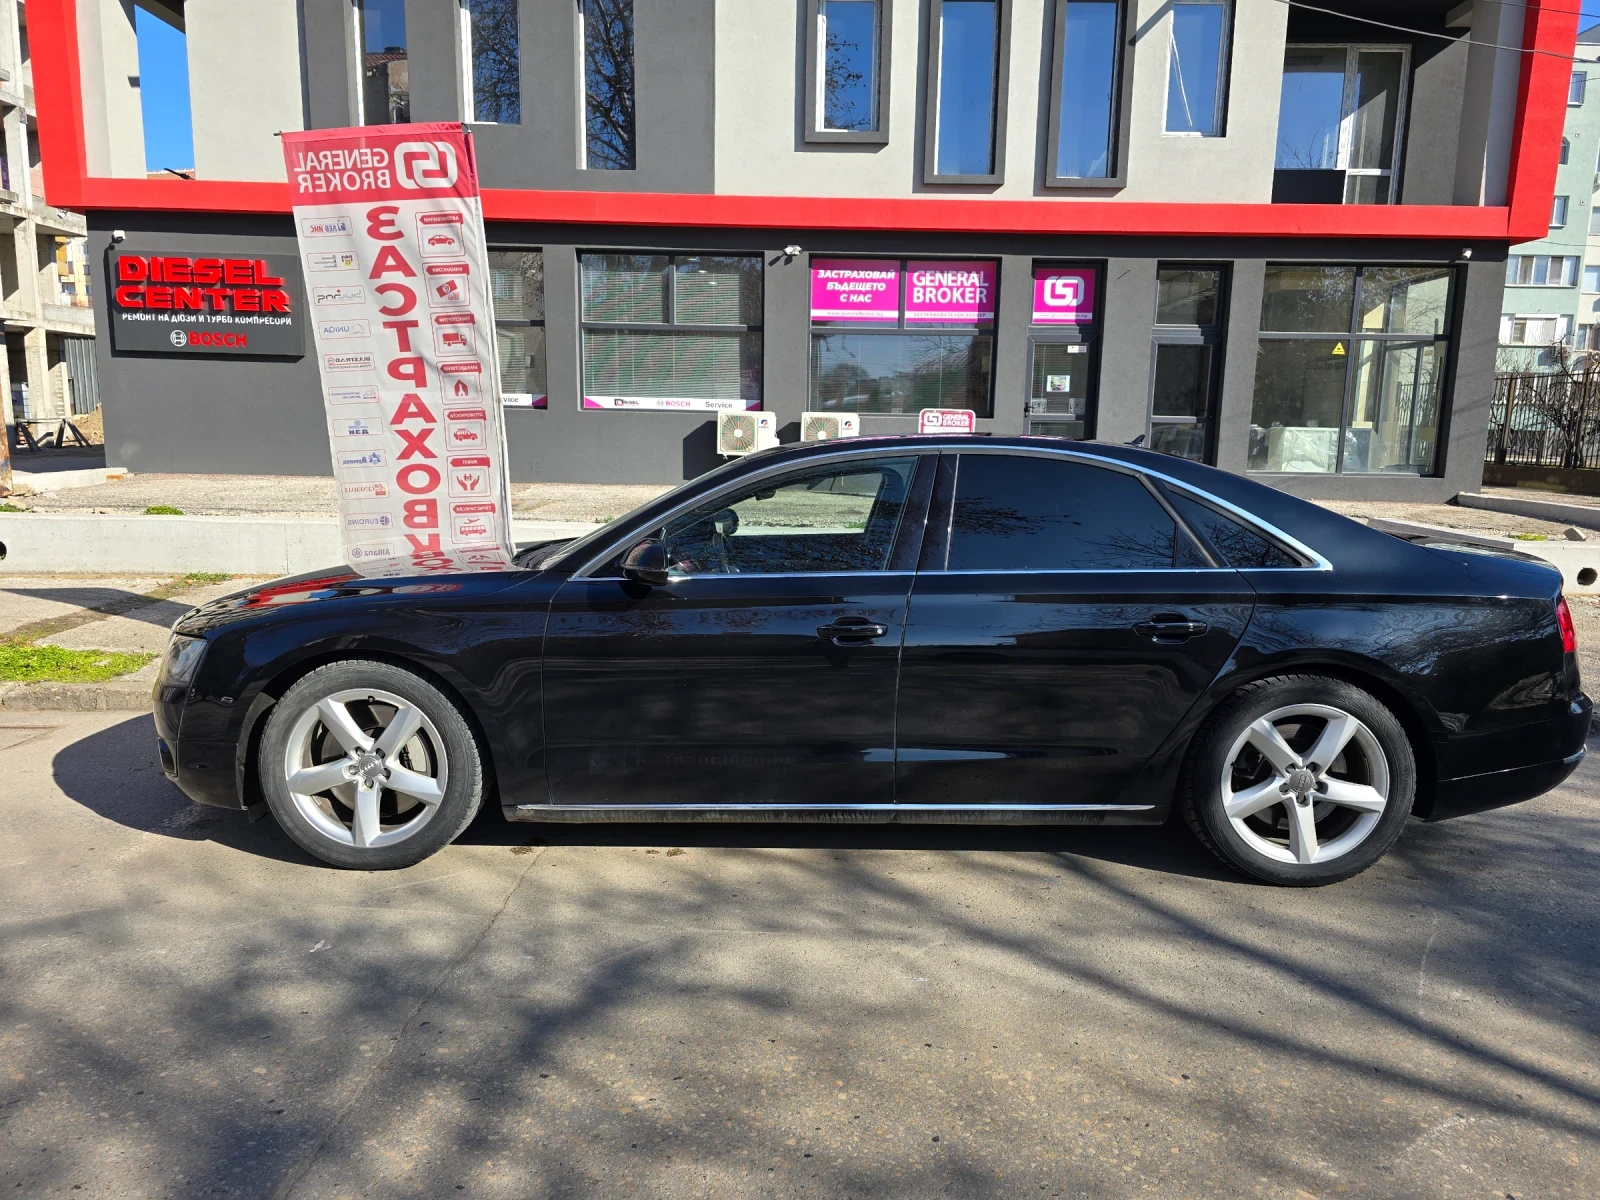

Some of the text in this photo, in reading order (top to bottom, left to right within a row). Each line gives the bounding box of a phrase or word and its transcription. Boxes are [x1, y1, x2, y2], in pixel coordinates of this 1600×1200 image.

[117, 255, 285, 286] DIESEL
[817, 268, 896, 280] ЗАСТРАХОВАЙ
[912, 269, 989, 287] GENERAL
[826, 281, 887, 292] БЪДЕЩЕТО
[115, 285, 292, 313] CENTER
[839, 293, 873, 303] С НАС
[912, 286, 987, 304] BROKER
[122, 312, 292, 326] РЕМОНТ НА ДЮЗИ И ТУРБО КОМПРЕСОРИ
[188, 331, 247, 348] BOSCH
[502, 395, 519, 403] vice
[665, 400, 691, 408] BOSCH
[942, 413, 970, 421] GENERAL
[942, 419, 970, 427] BROKER
